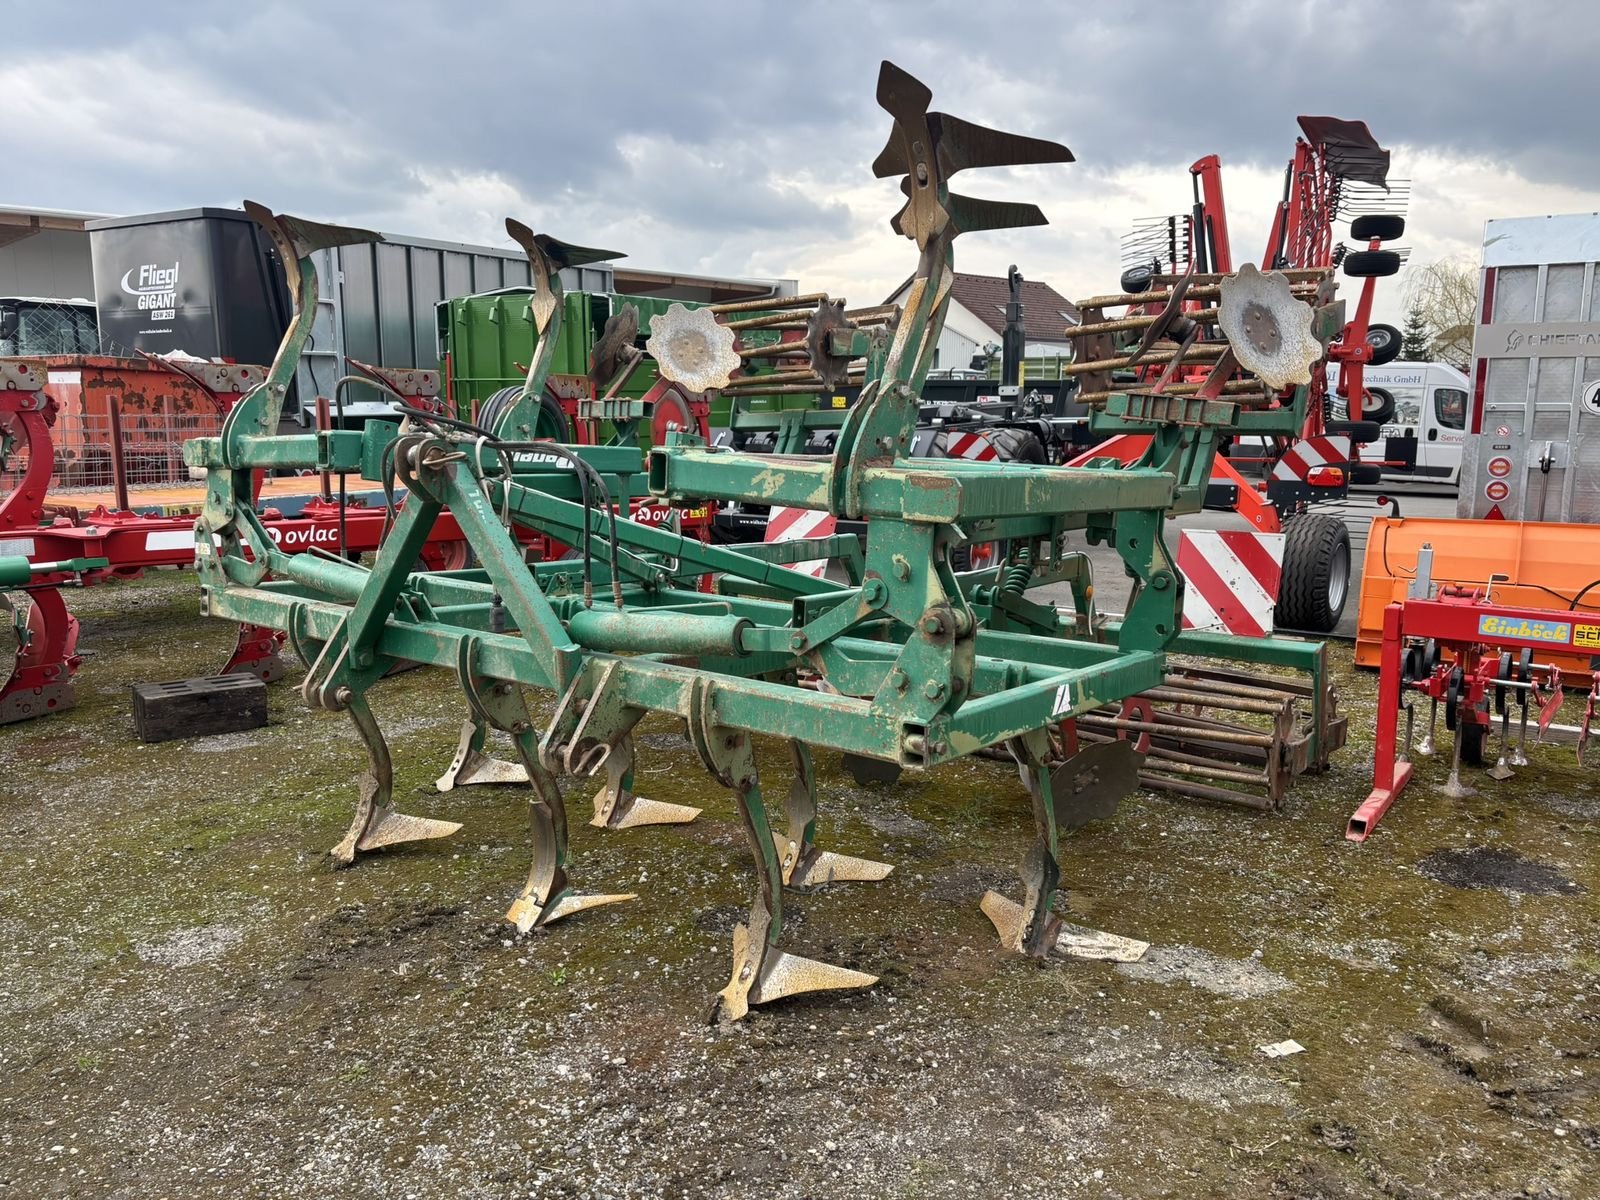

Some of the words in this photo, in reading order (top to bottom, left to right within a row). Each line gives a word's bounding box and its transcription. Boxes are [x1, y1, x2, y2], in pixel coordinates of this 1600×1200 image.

[139, 262, 179, 289] Fliegl
[138, 293, 176, 310] GIGANT
[1592, 388, 1600, 408] 4
[652, 509, 688, 521] ovc
[285, 525, 338, 544] ovlac
[1481, 618, 1568, 641] Einböck
